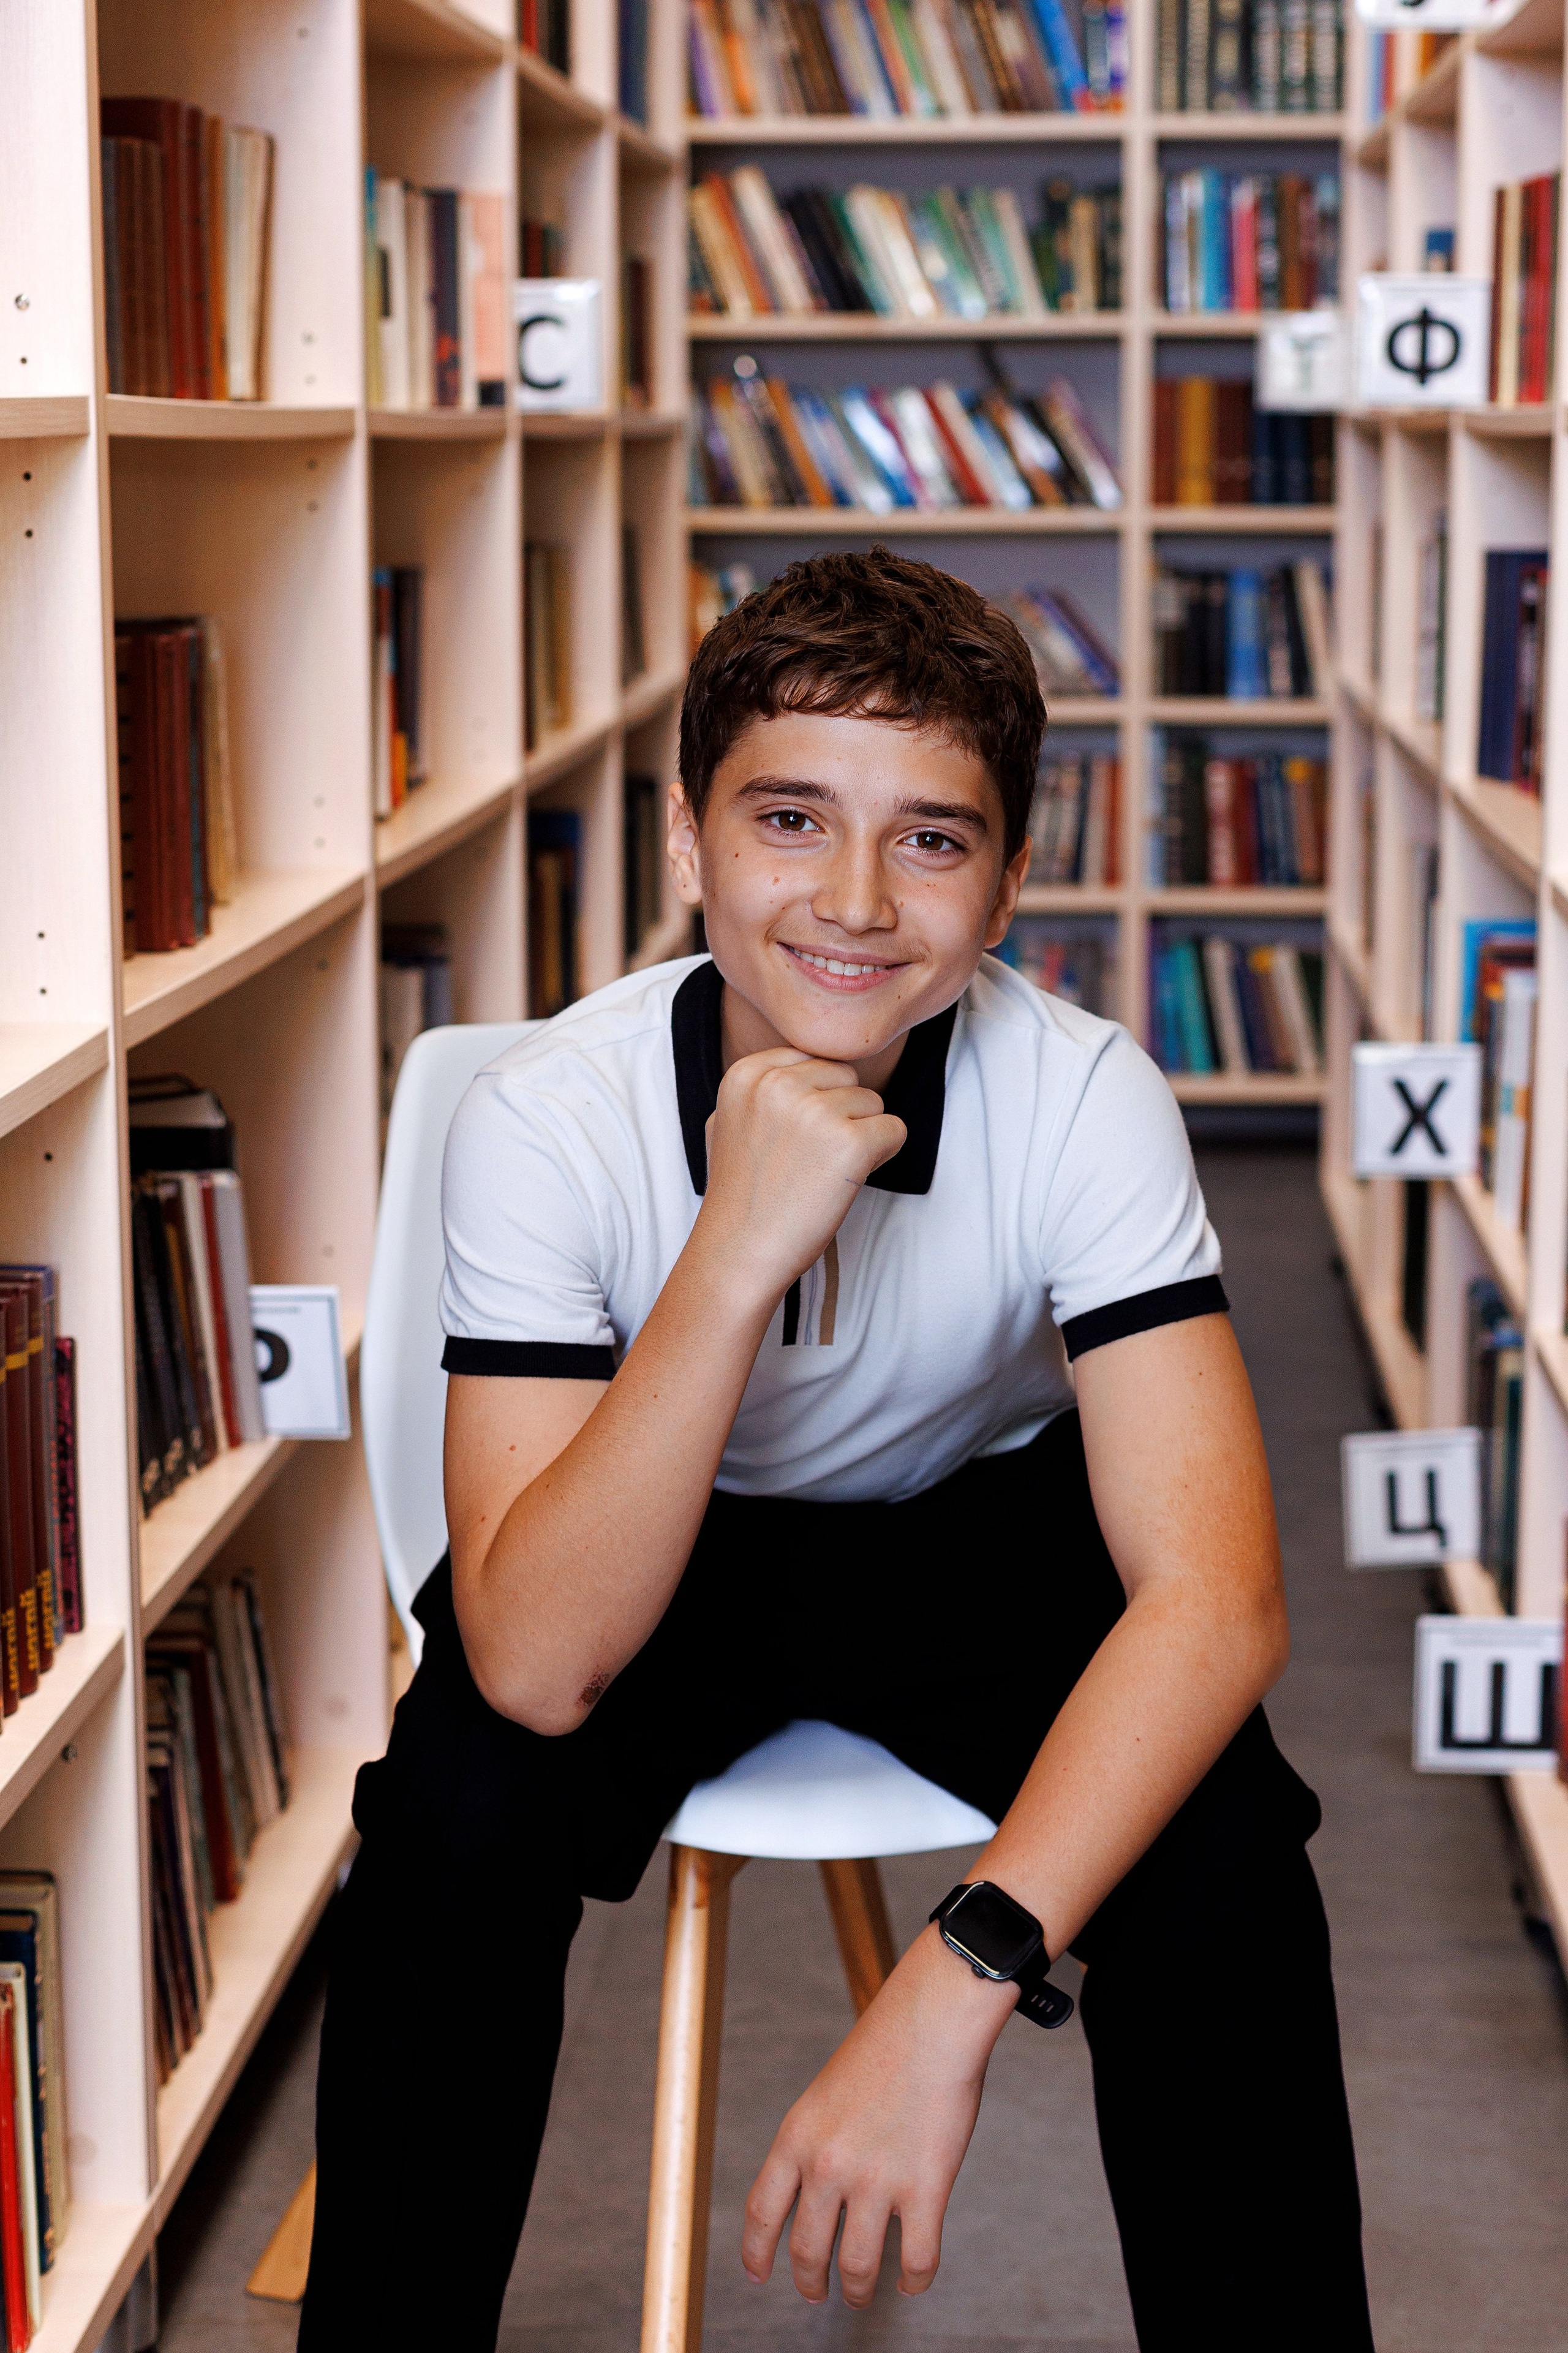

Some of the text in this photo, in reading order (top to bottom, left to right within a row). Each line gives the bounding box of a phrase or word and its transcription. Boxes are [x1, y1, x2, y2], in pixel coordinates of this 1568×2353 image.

[518, 313, 567, 391] С
[1386, 305, 1461, 387] Ф
[1392, 1076, 1450, 1156] Х
[1385, 1468, 1449, 1550] Ц
[1442, 1660, 1558, 1751] Ш
